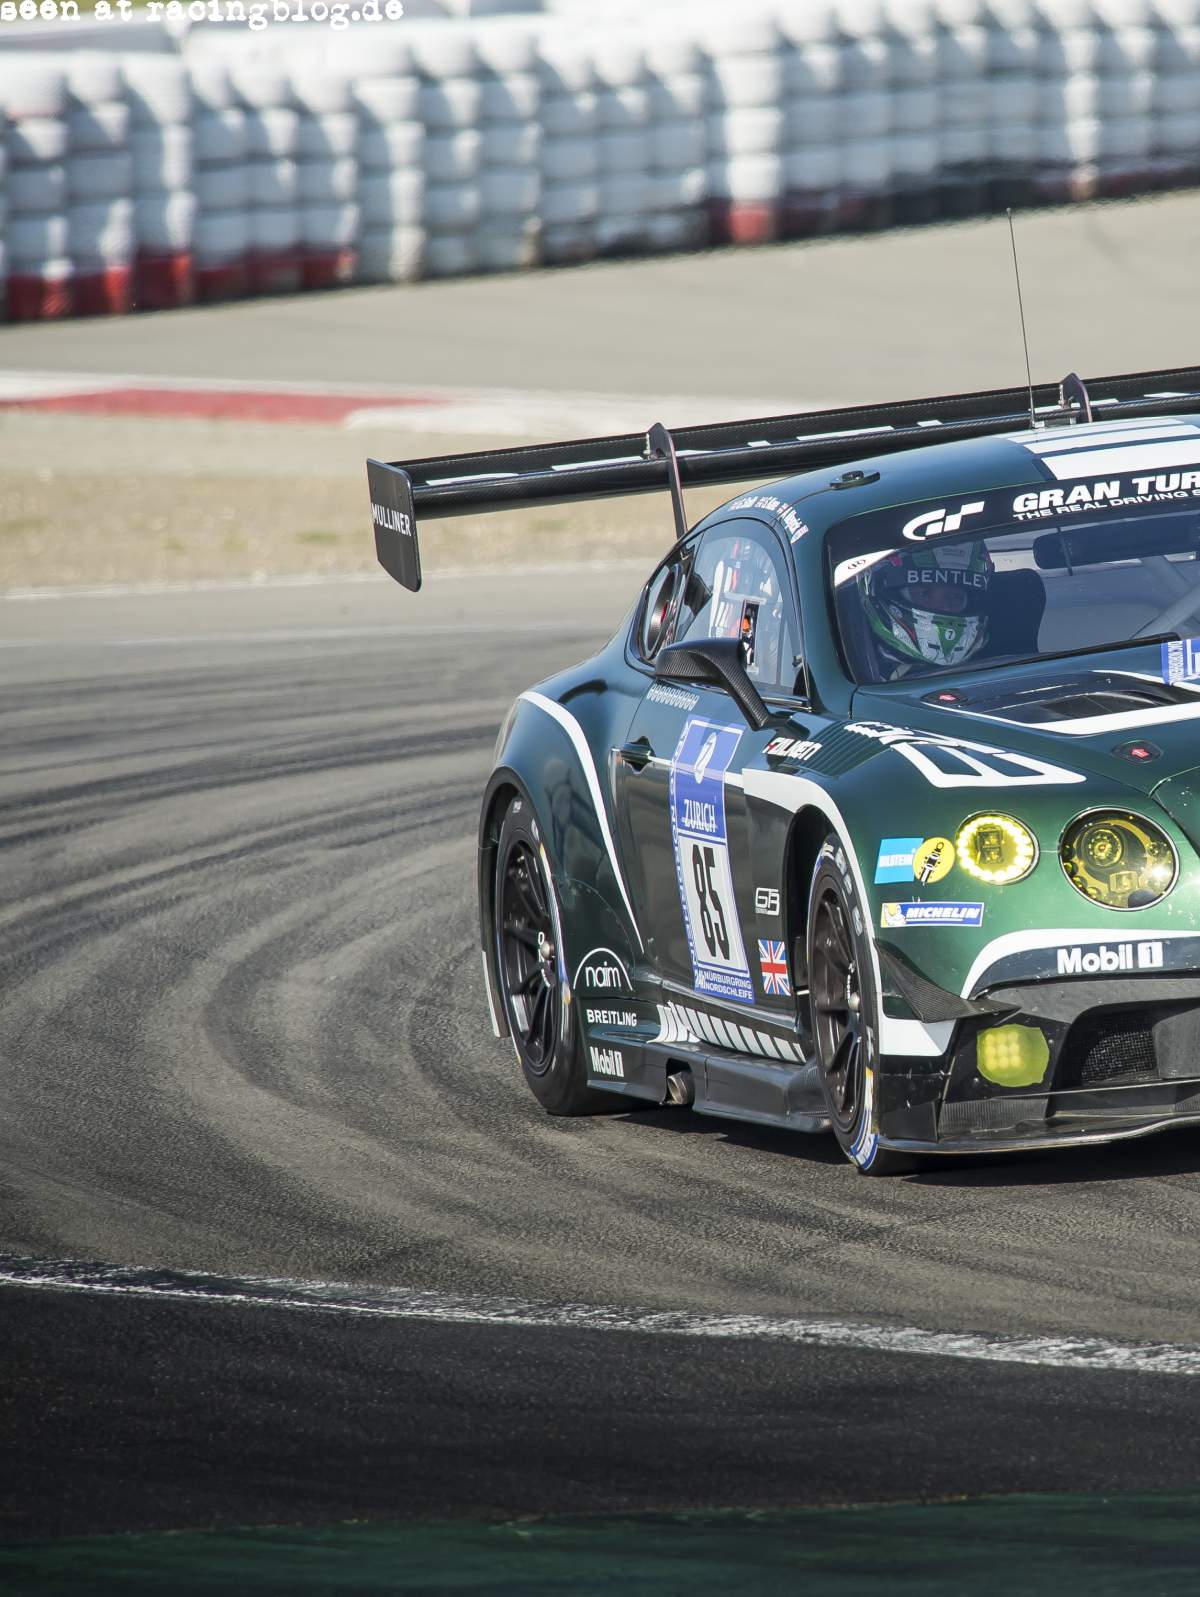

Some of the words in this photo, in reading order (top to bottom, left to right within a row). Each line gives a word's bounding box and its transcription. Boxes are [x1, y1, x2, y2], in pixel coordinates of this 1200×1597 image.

[1012, 480, 1121, 513] GRAN
[1012, 508, 1053, 522] THE
[1056, 502, 1108, 515] REAL
[1109, 490, 1189, 507] DRIVING
[371, 502, 412, 537] MULLINER
[907, 569, 989, 589] BENTLEY
[683, 798, 718, 833] ZURICH
[692, 843, 731, 961] 85
[906, 907, 981, 919] MICHELIN
[585, 960, 622, 988] naim
[1057, 943, 1134, 974] Mobil
[704, 981, 753, 1000] NORDSCHLEIFE
[586, 1008, 638, 1028] BREITLING
[589, 1046, 616, 1077] Mobil
